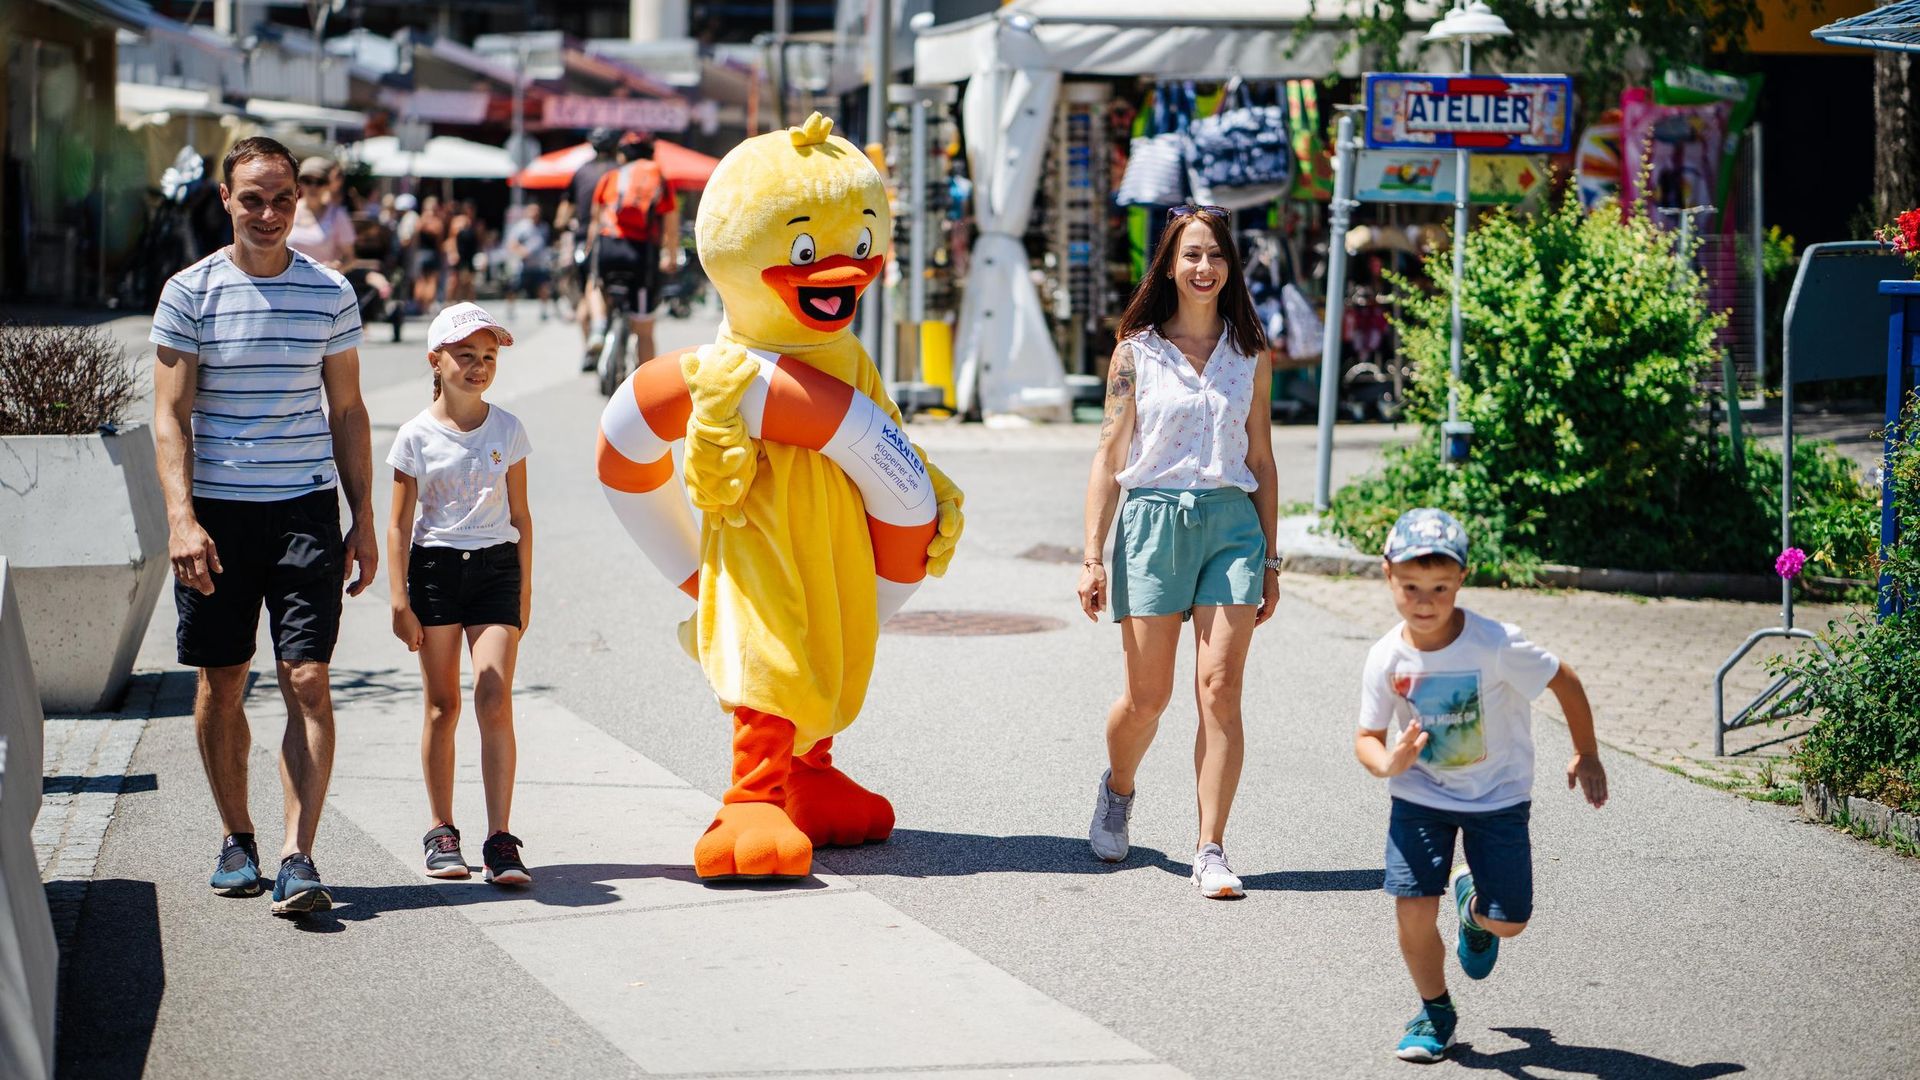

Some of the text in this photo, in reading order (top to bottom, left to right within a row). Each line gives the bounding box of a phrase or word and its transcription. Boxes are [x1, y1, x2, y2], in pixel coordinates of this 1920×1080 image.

[1409, 95, 1529, 123] ATELIER
[871, 453, 909, 493] Südkärnten
[875, 442, 919, 490] Klopeiner See
